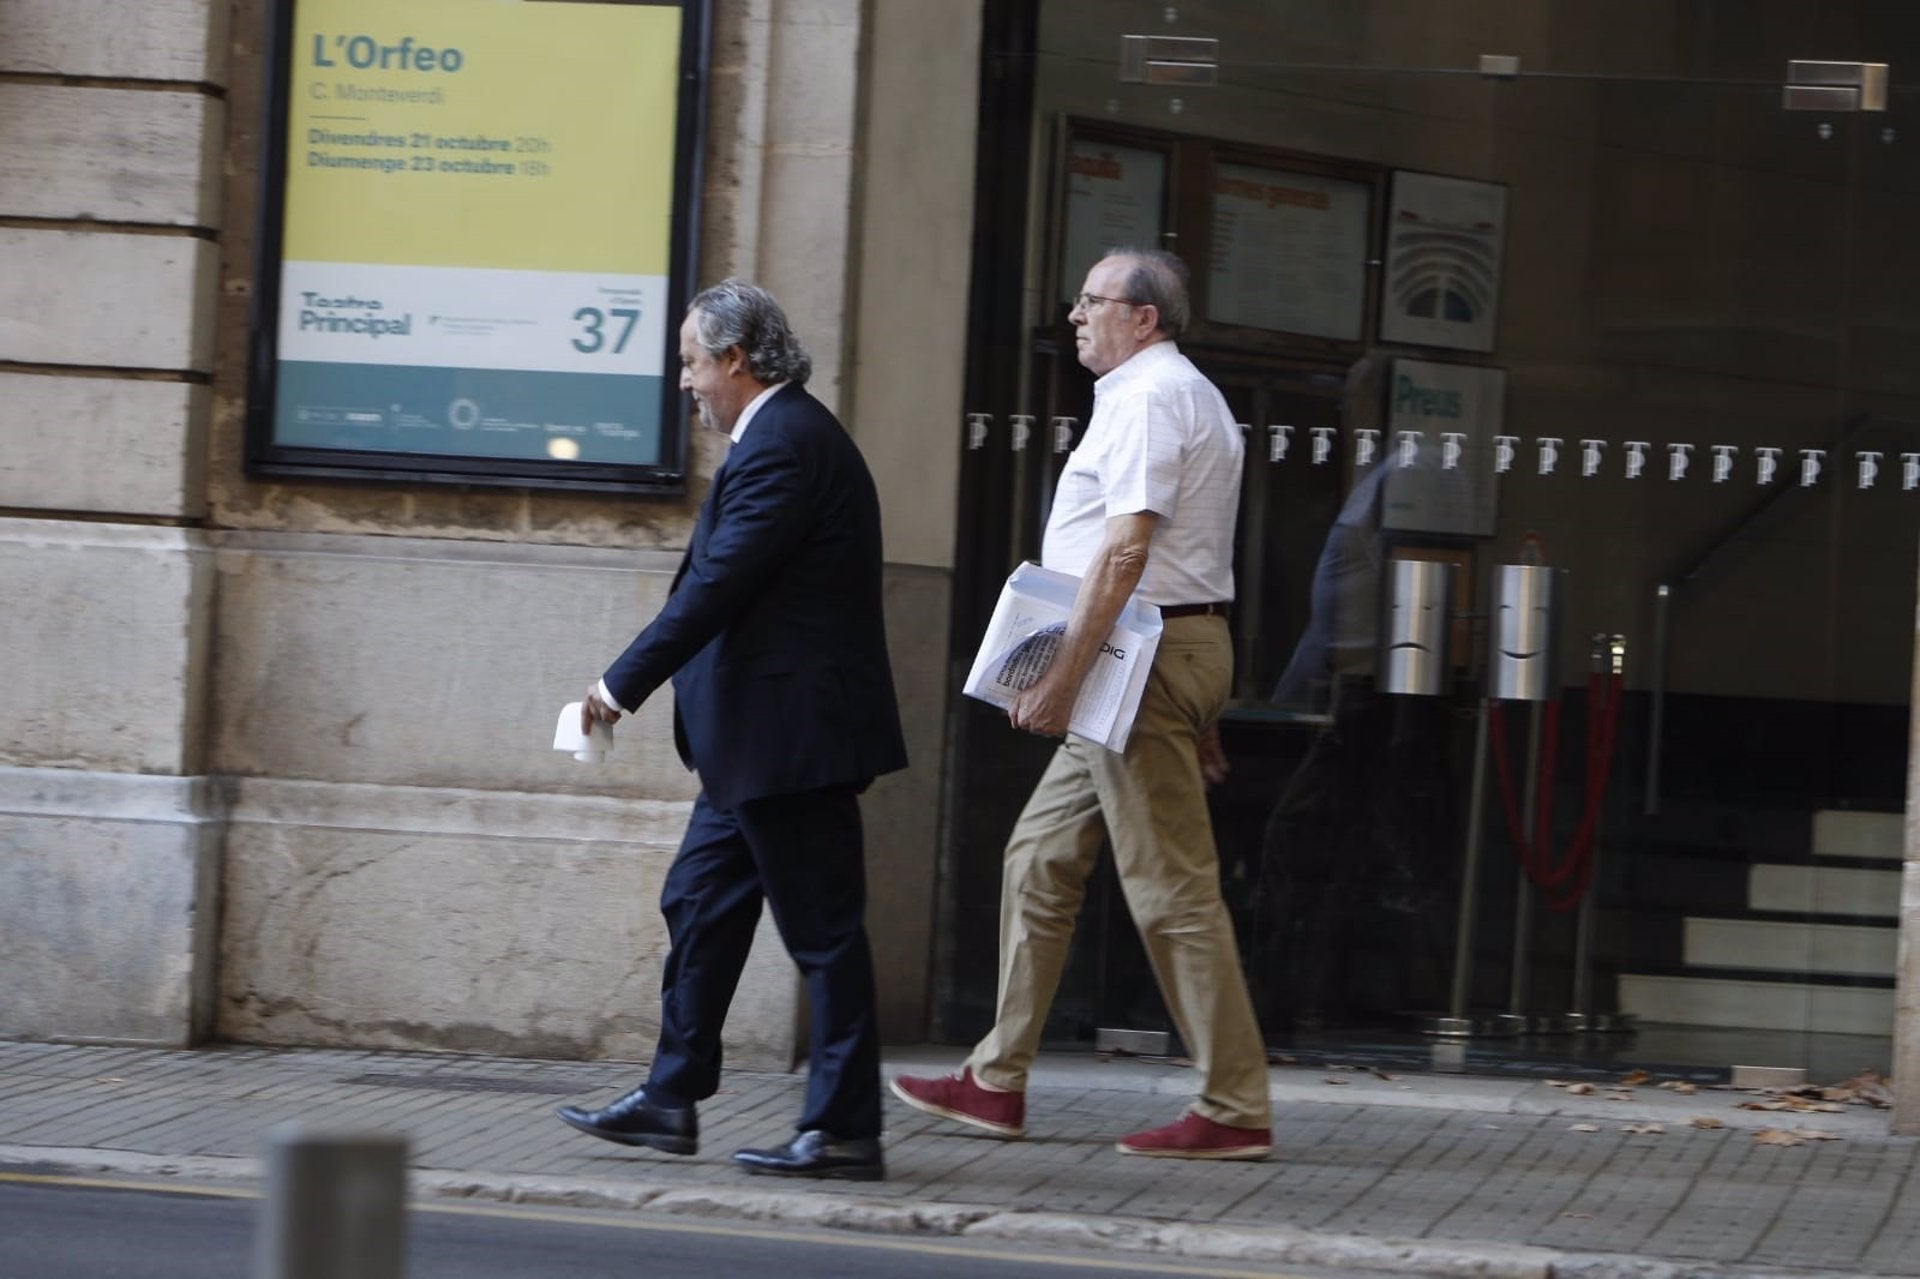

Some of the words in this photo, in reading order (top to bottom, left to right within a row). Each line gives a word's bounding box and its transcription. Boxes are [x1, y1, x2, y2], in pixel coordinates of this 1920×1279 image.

[313, 34, 463, 73] L'Orfeo
[307, 128, 405, 148] Divendres
[411, 133, 431, 148] 21
[435, 136, 511, 151] octubre
[307, 151, 405, 173] Diumenge
[411, 156, 434, 171] 23
[439, 158, 515, 174] octubre
[299, 310, 411, 340] Principal
[571, 307, 641, 354] 37
